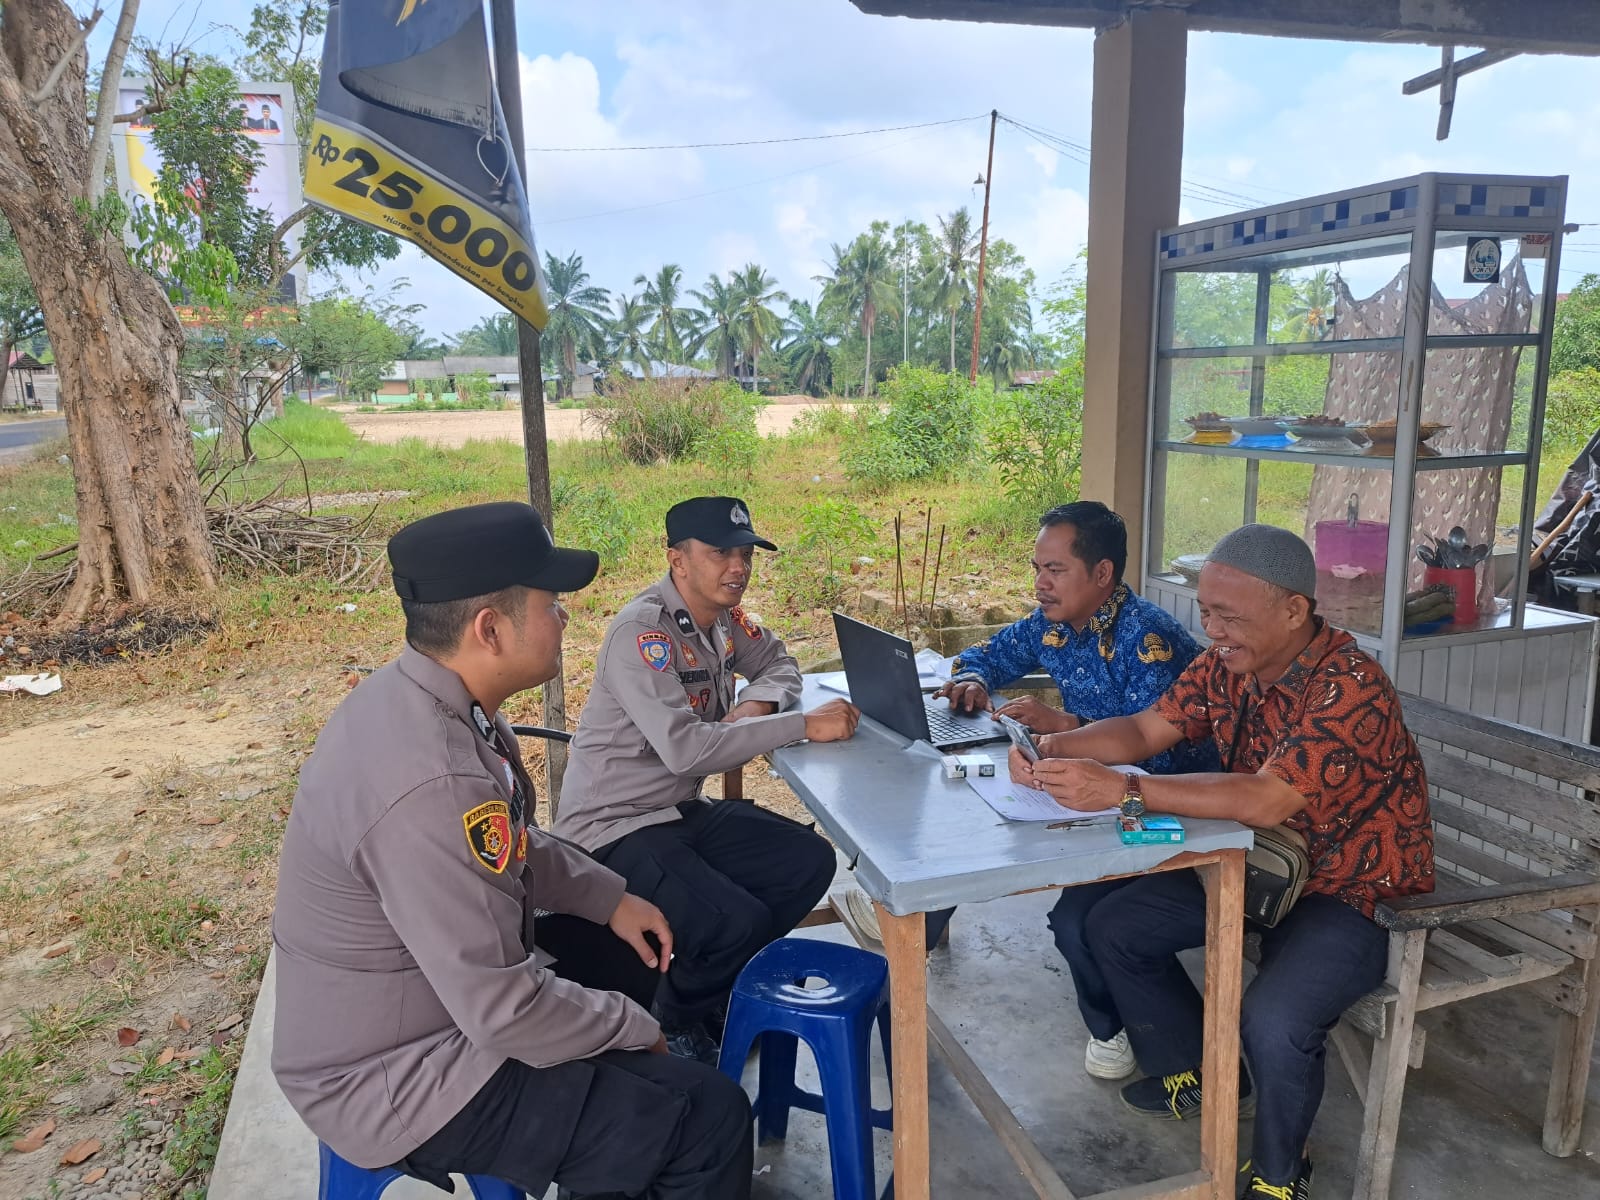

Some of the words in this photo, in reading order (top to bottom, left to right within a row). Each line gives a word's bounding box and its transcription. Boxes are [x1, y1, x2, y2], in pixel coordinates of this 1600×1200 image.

[312, 134, 340, 167] Rp
[334, 147, 537, 292] 25.000
[481, 278, 496, 289] per
[496, 286, 525, 310] bungkus
